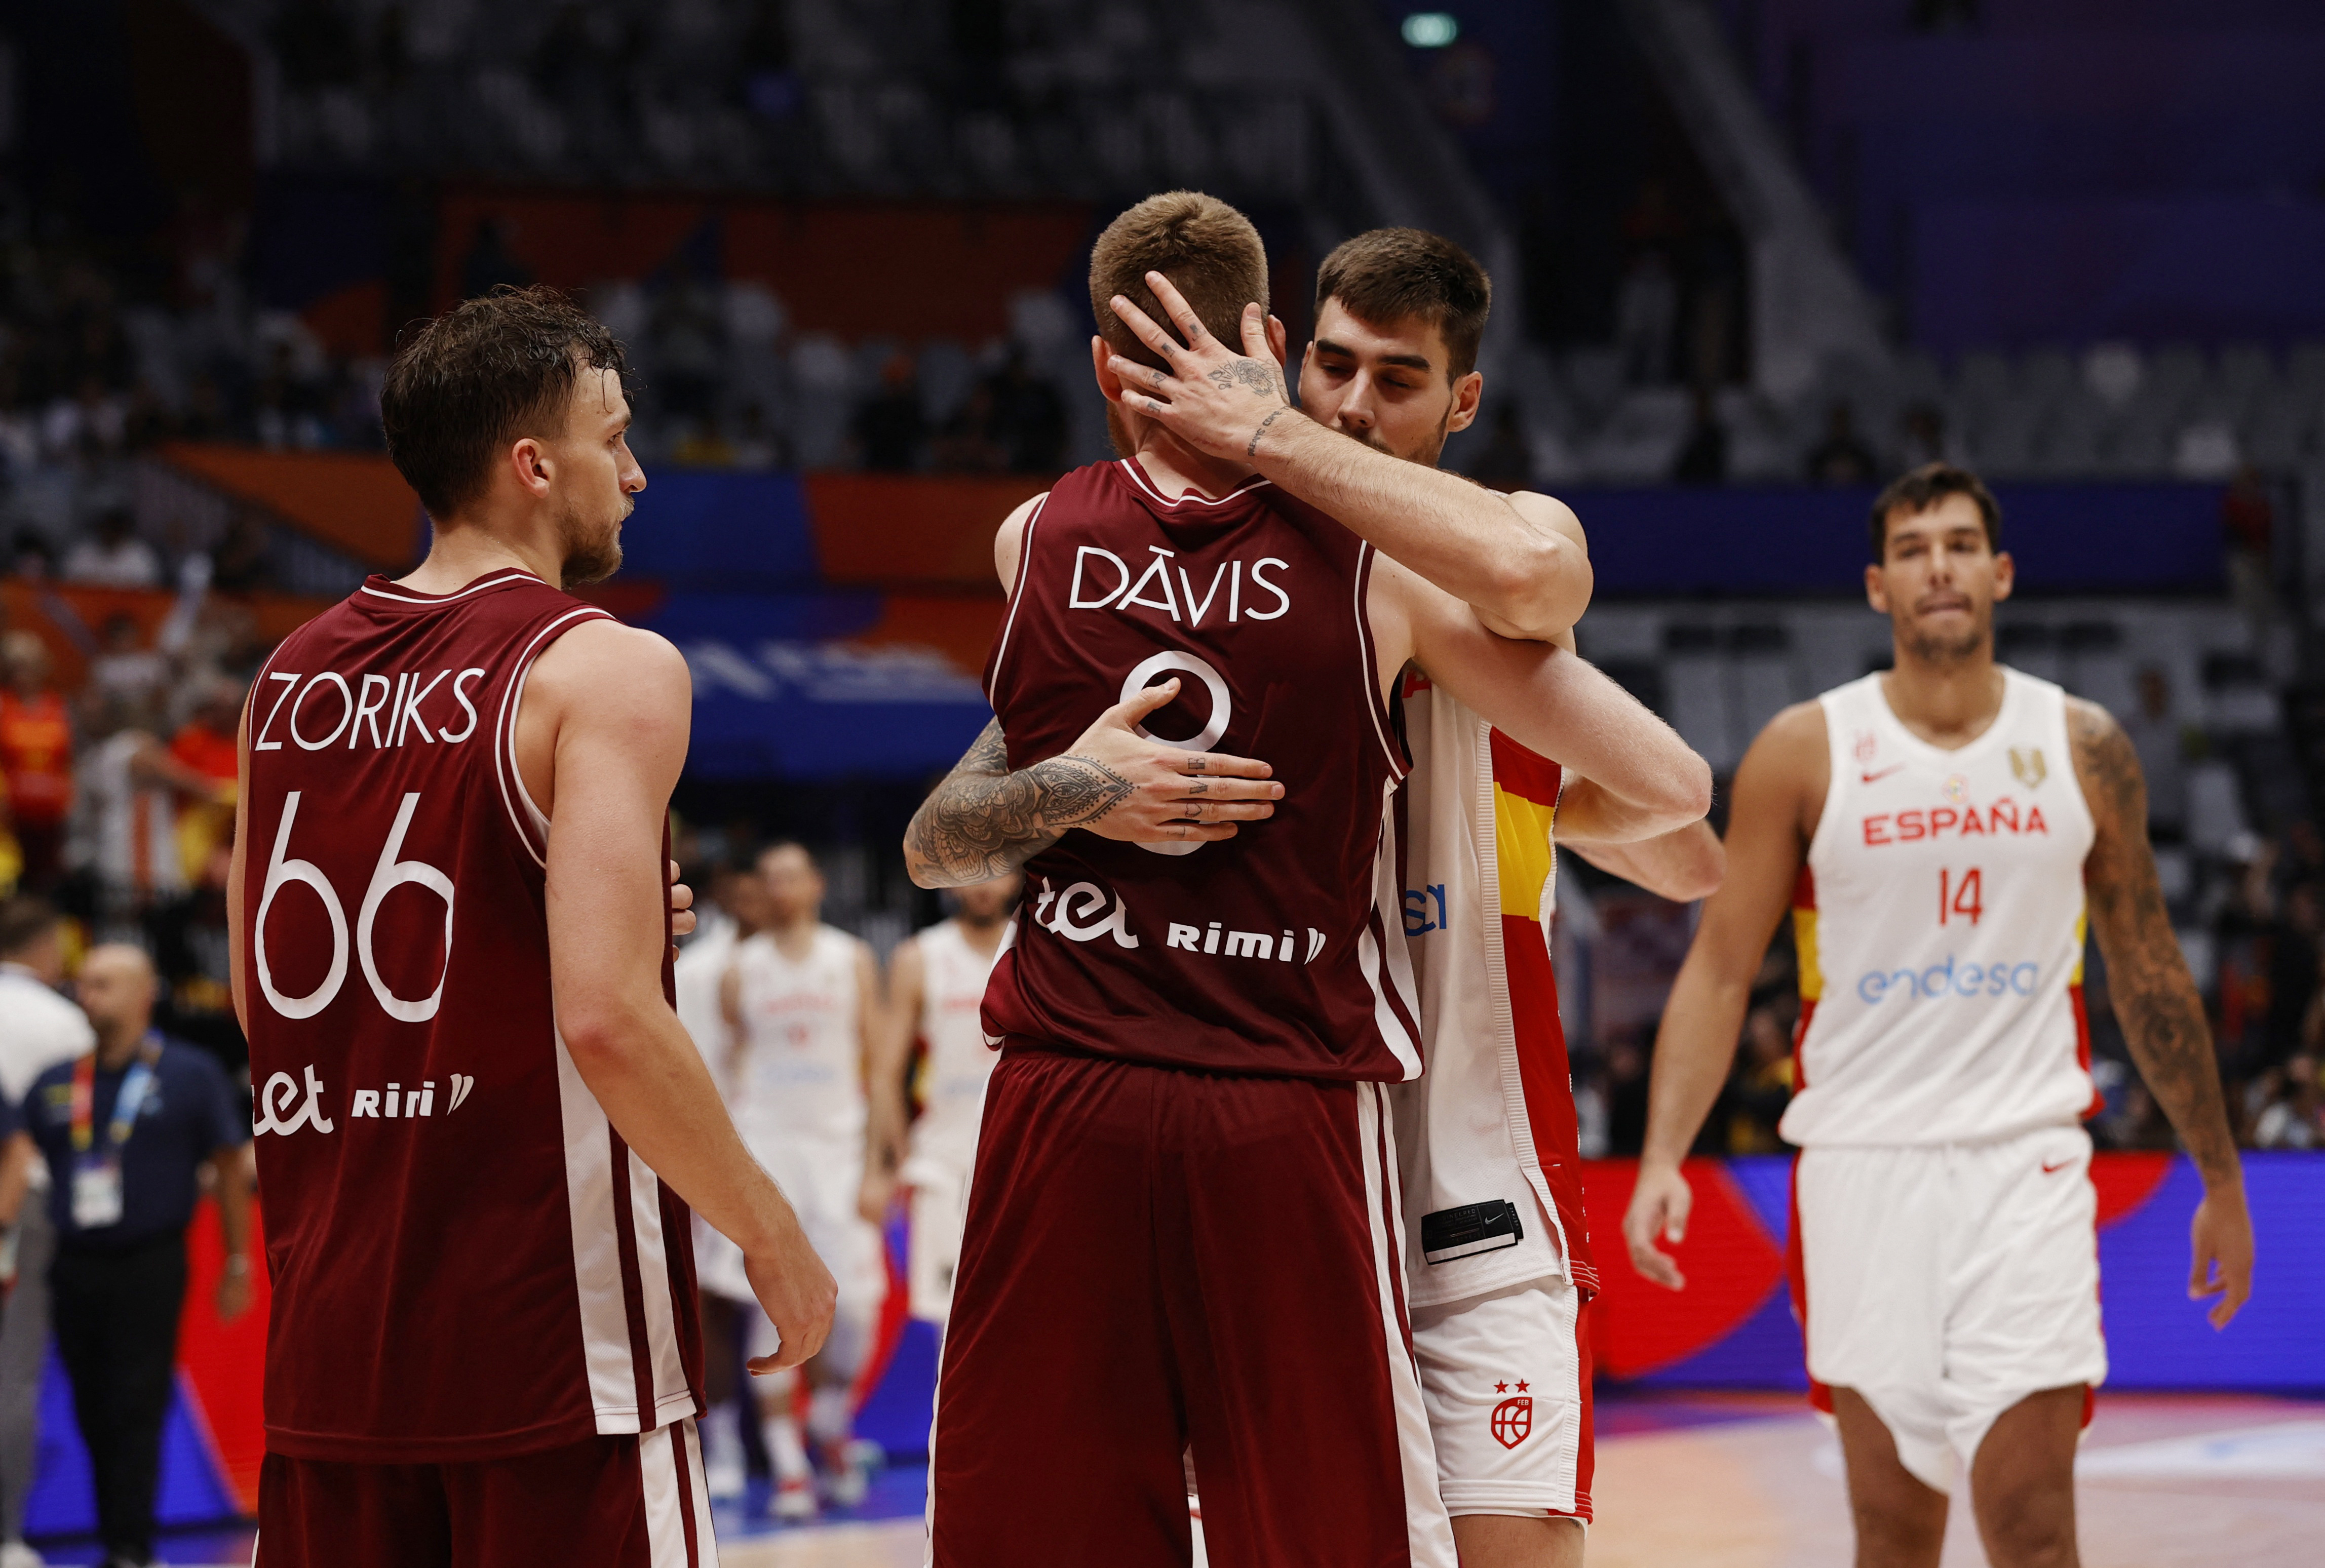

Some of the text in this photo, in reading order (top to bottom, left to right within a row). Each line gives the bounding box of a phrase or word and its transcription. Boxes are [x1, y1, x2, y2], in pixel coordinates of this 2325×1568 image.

[1069, 545, 1290, 627] DĀVIS
[255, 668, 486, 751] ZORIKS
[1863, 797, 2048, 847] ESPAÑA
[255, 791, 455, 1023] 66
[1939, 867, 1983, 926] 14
[1167, 922, 1294, 962] Rimi
[1857, 954, 2039, 1004] endesa
